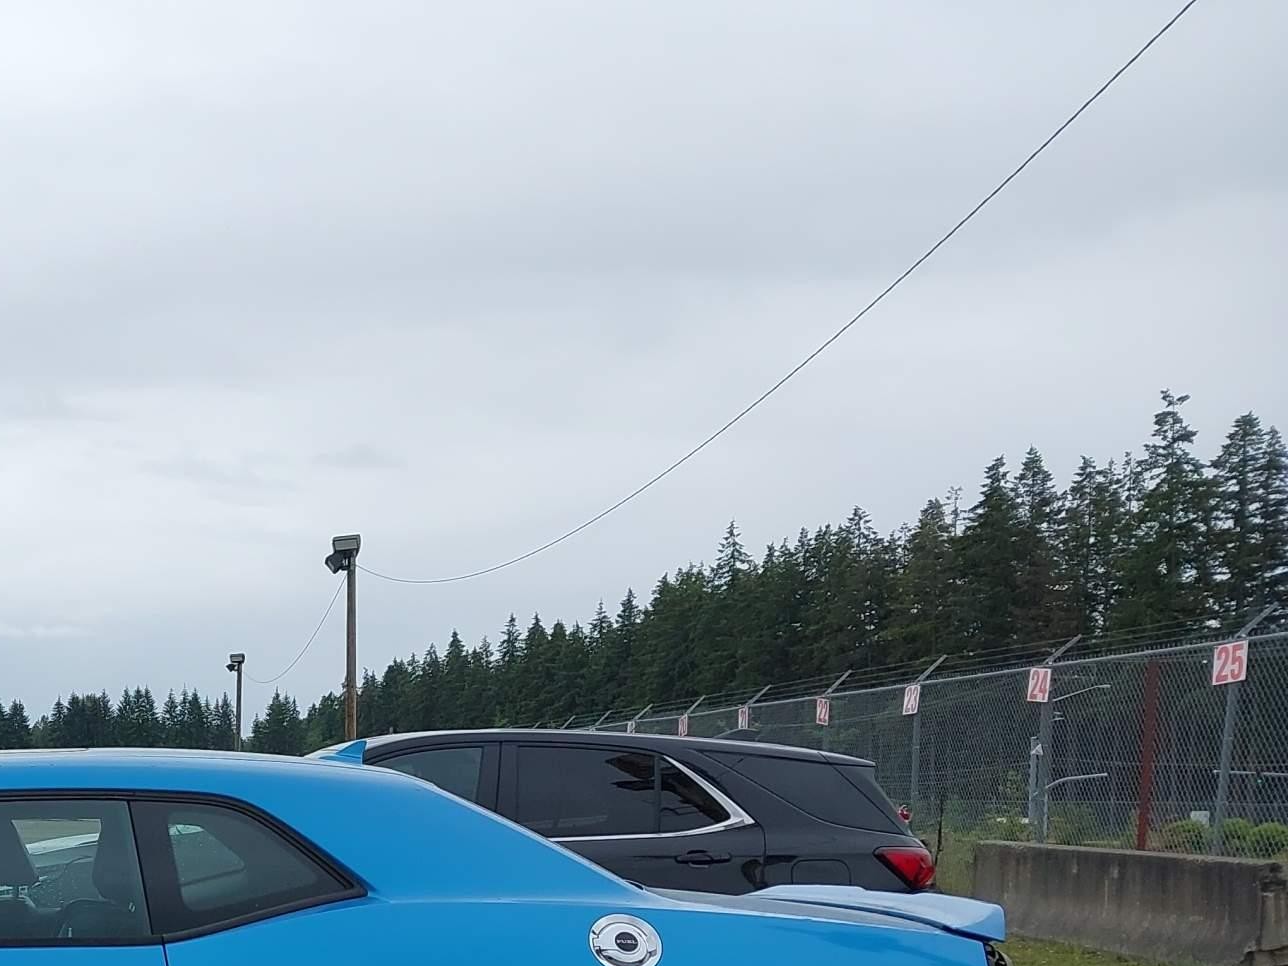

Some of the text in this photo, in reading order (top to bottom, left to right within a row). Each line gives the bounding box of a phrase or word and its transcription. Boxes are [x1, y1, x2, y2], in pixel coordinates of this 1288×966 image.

[1215, 645, 1245, 684] 25
[1029, 670, 1049, 699] 24
[904, 687, 919, 713] 23
